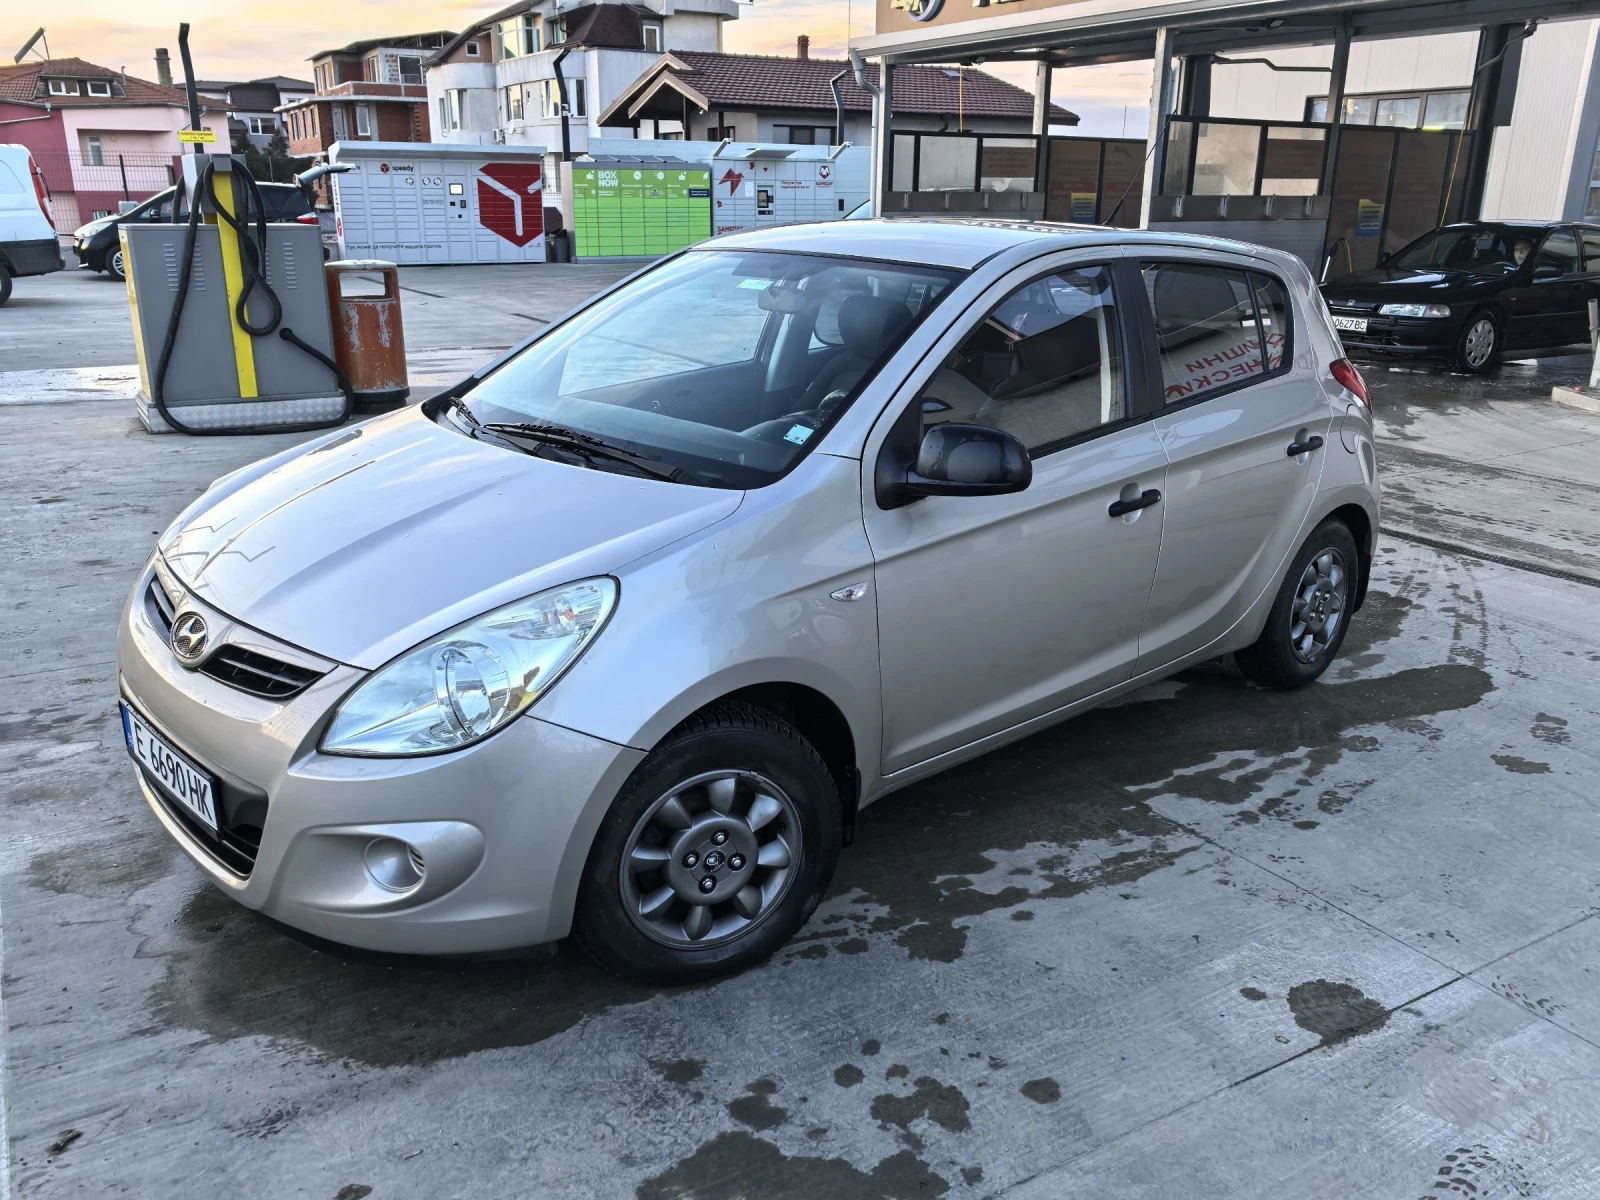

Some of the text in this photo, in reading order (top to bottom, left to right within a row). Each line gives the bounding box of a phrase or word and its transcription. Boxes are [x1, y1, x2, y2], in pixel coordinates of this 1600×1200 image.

[392, 164, 414, 172] speedy
[598, 171, 616, 179] BOX
[598, 179, 618, 187] NOW
[1334, 318, 1355, 329] 0627
[133, 720, 146, 761] E
[150, 738, 186, 799] 6690
